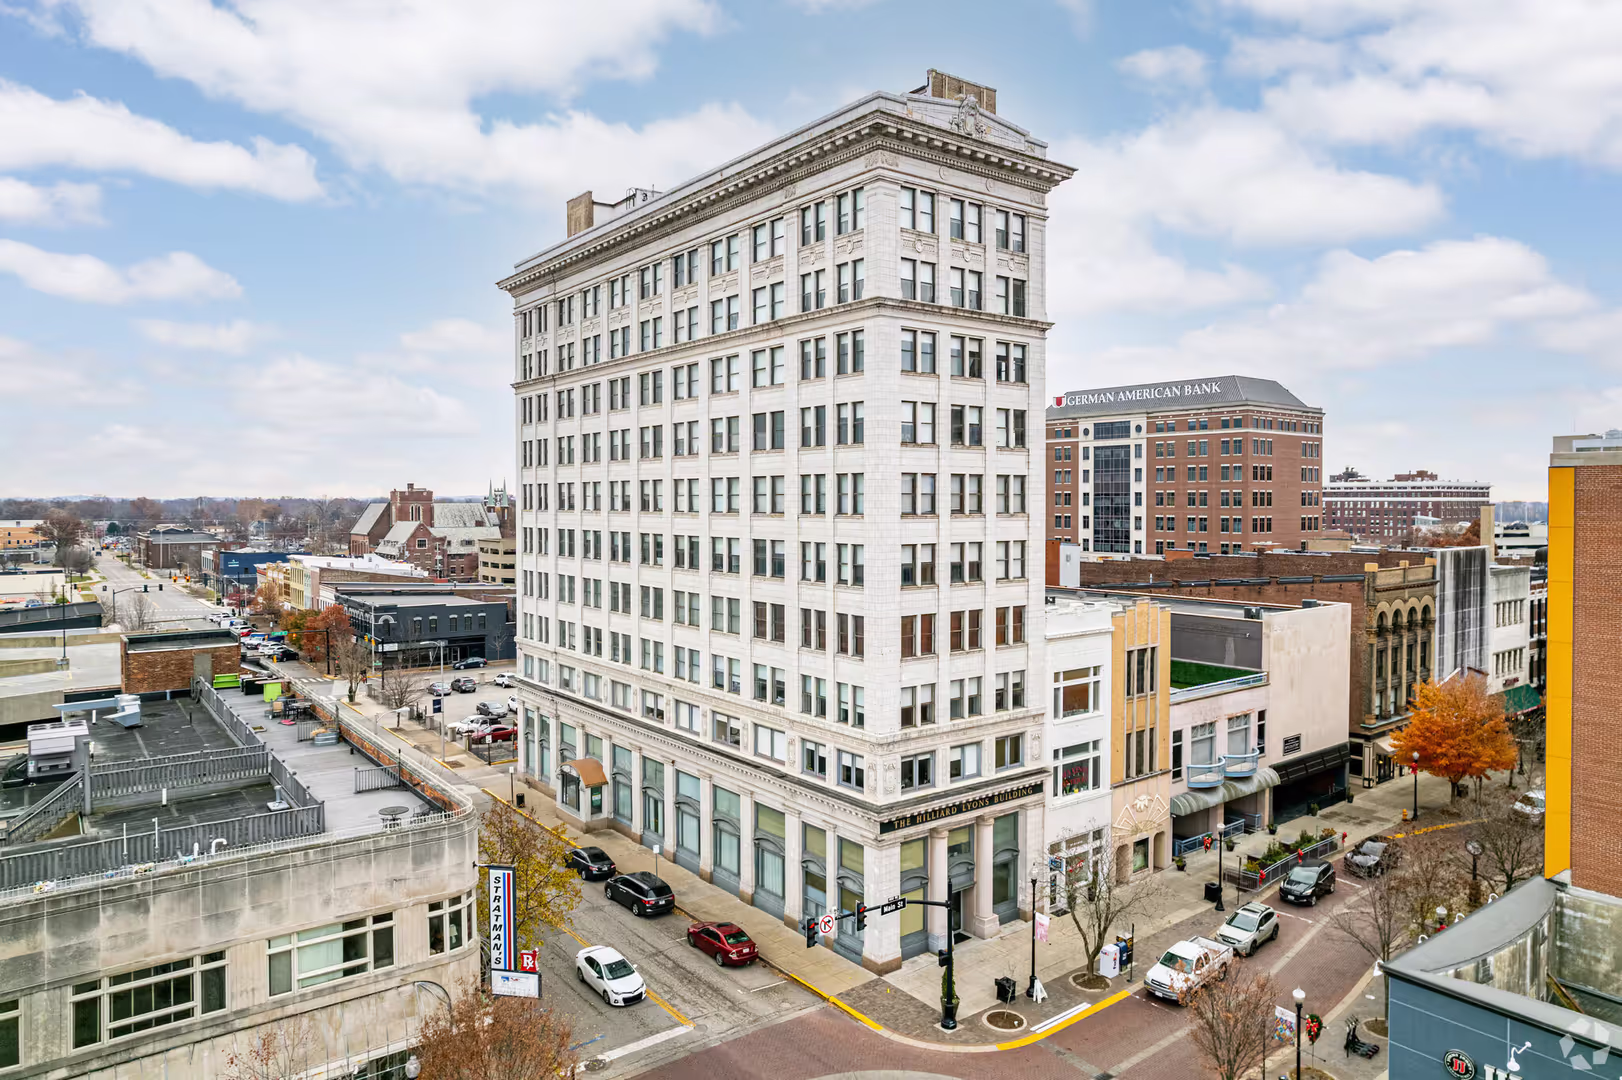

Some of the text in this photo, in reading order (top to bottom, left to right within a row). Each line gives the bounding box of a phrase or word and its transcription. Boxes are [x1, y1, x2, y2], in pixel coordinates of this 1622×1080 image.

[1067, 381, 1222, 406] GERMAN AMERICAN BANK
[893, 787, 1033, 829] THE HILLIARD LYONS BUILDING
[492, 876, 503, 965] STRATMAN'S
[883, 904, 896, 913] Main
